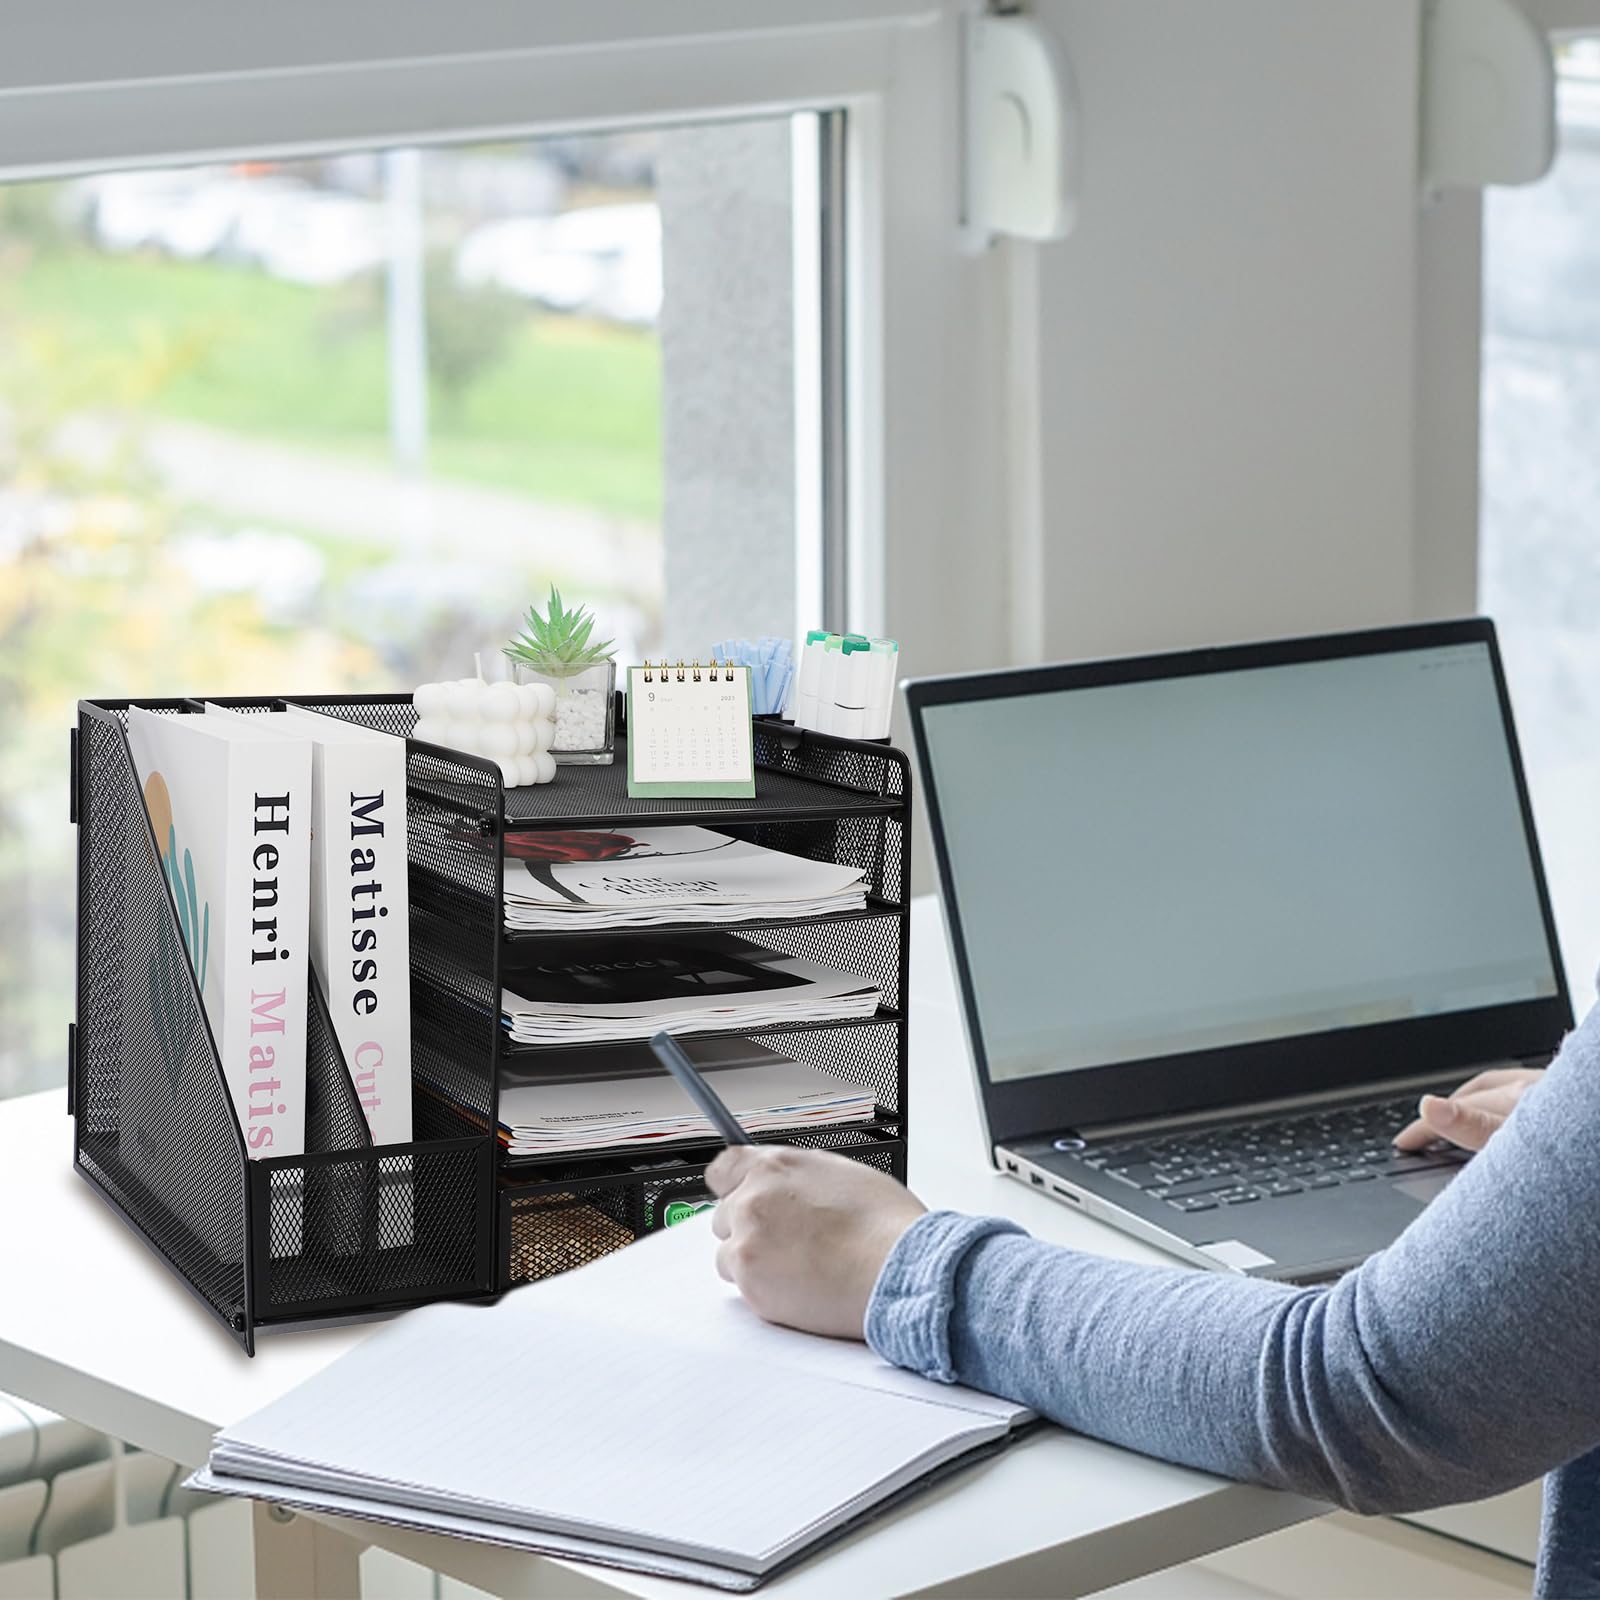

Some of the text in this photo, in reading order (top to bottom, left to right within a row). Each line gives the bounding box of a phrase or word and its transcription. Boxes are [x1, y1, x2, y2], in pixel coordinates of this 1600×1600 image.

[648, 692, 655, 702] 9
[247, 791, 290, 1159] Henri Matis
[350, 789, 389, 1016] Matisse
